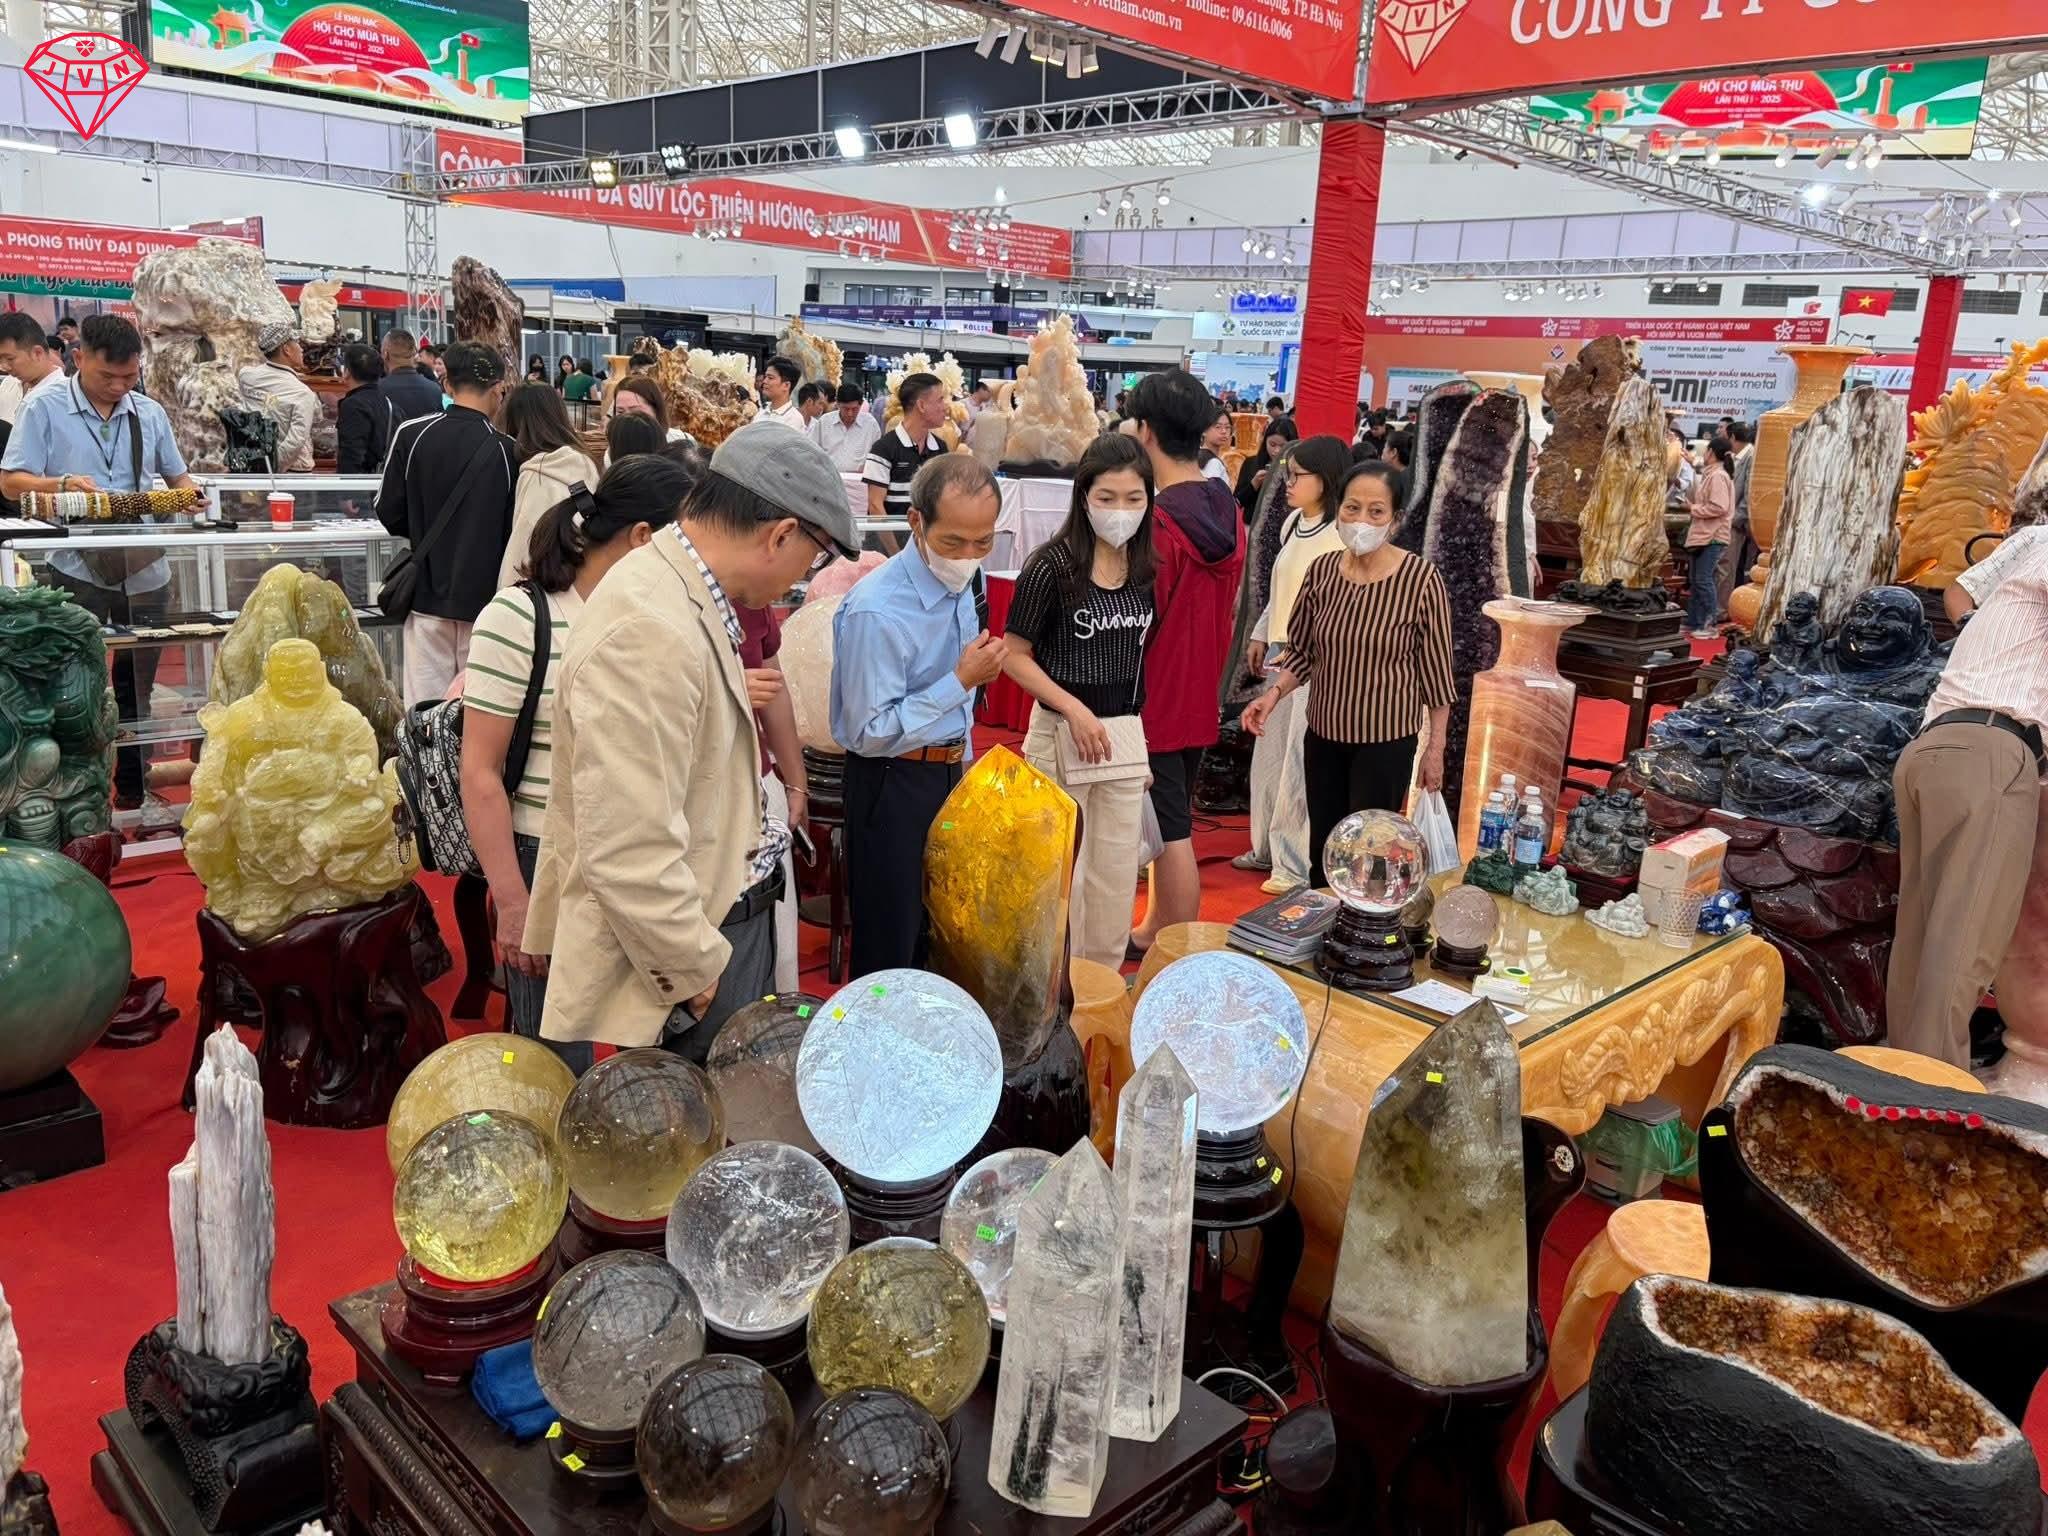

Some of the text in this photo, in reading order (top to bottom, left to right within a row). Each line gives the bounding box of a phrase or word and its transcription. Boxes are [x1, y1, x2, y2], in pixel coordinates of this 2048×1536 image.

[1231, 5, 1293, 40] 09.6116.0066
[1310, 4, 1324, 24] Hà
[1325, 9, 1344, 32] Nội
[1760, 94, 1781, 104] 2025
[671, 183, 705, 223] LỘC
[759, 200, 816, 232] HƯƠNG
[7, 232, 63, 249] PHONG
[66, 234, 103, 252] THỦY
[107, 240, 133, 257] ĐẠI
[1709, 379, 1777, 390] press metal
